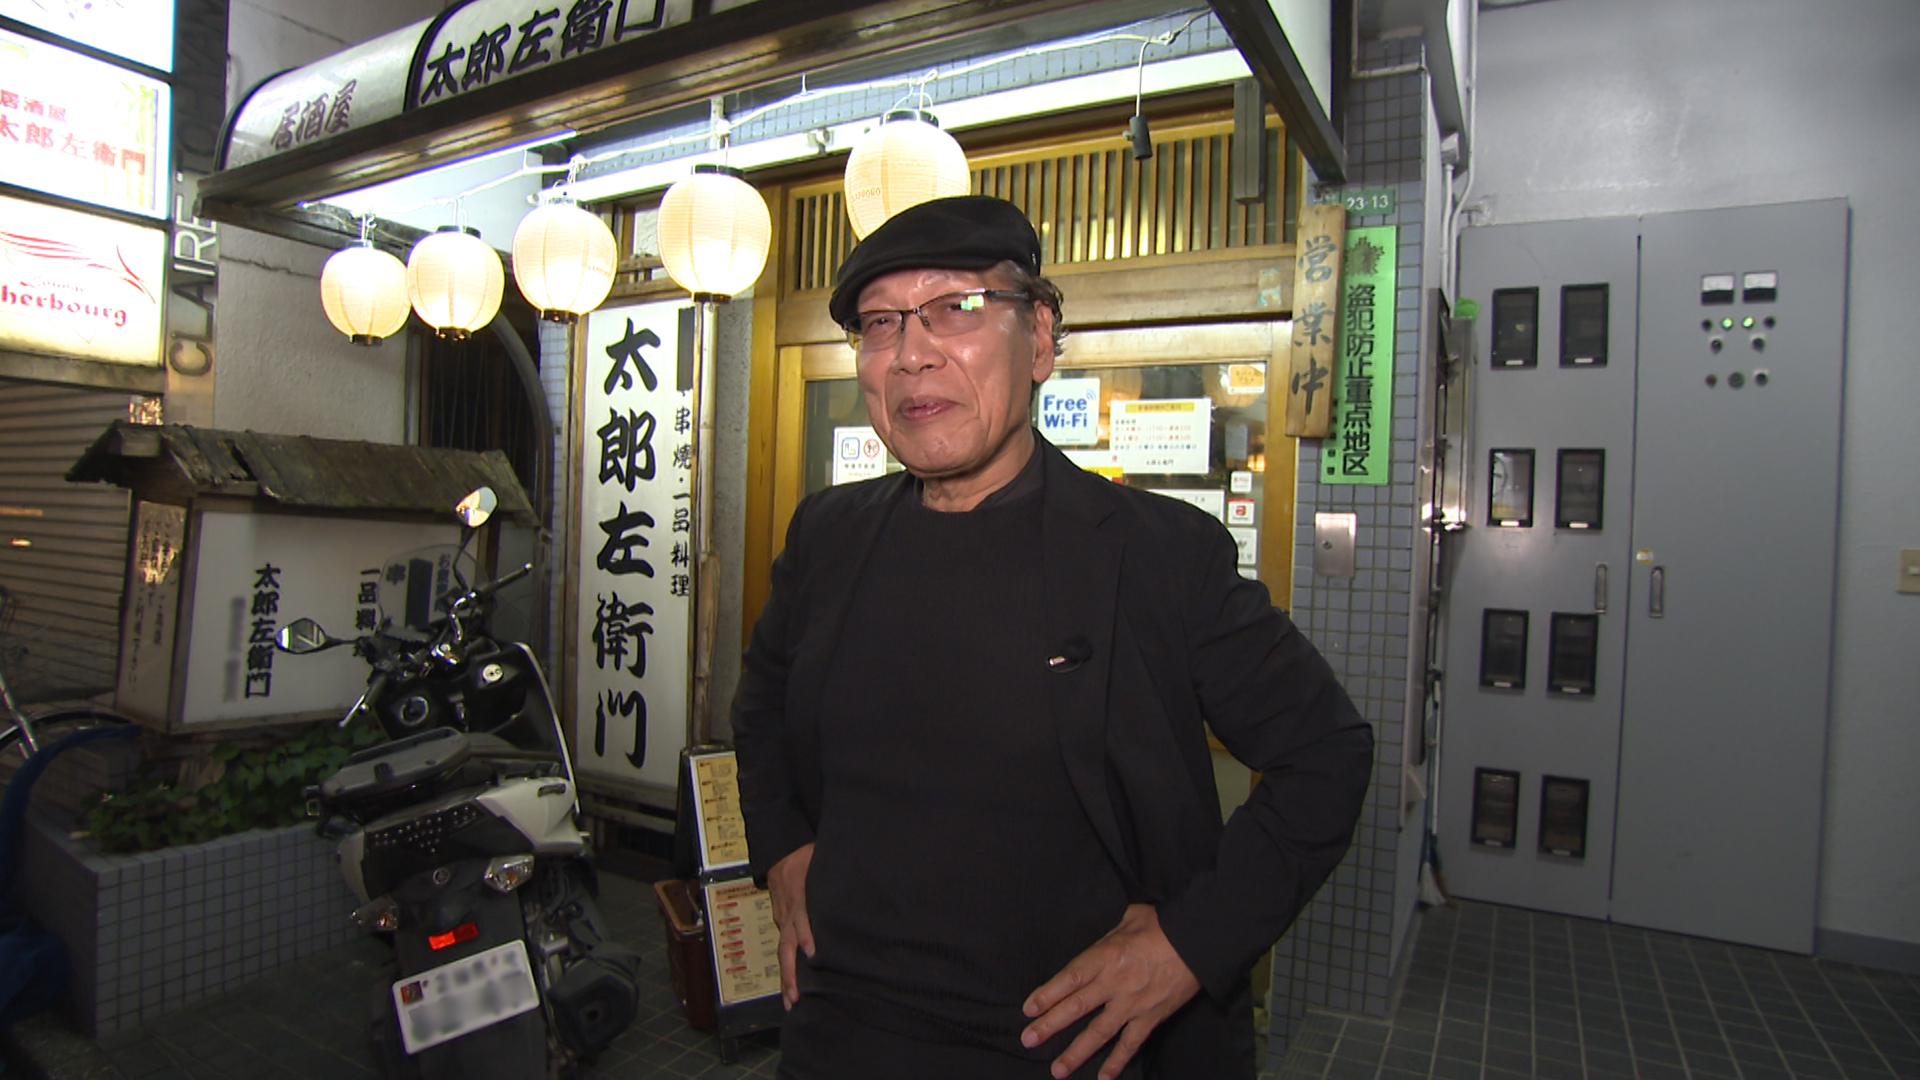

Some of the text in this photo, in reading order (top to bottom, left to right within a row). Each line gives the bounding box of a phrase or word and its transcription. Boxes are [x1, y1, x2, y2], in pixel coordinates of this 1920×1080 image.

[271, 78, 357, 151] 居酒屋
[1292, 235, 1338, 416] 営業中
[1343, 284, 1375, 475] 盗犯防止重点地区
[1043, 394, 1087, 411] Free
[1044, 412, 1087, 428] Wi-Fi
[593, 317, 661, 769] 太郎左衛門
[245, 563, 281, 699] 太郎左衛門
